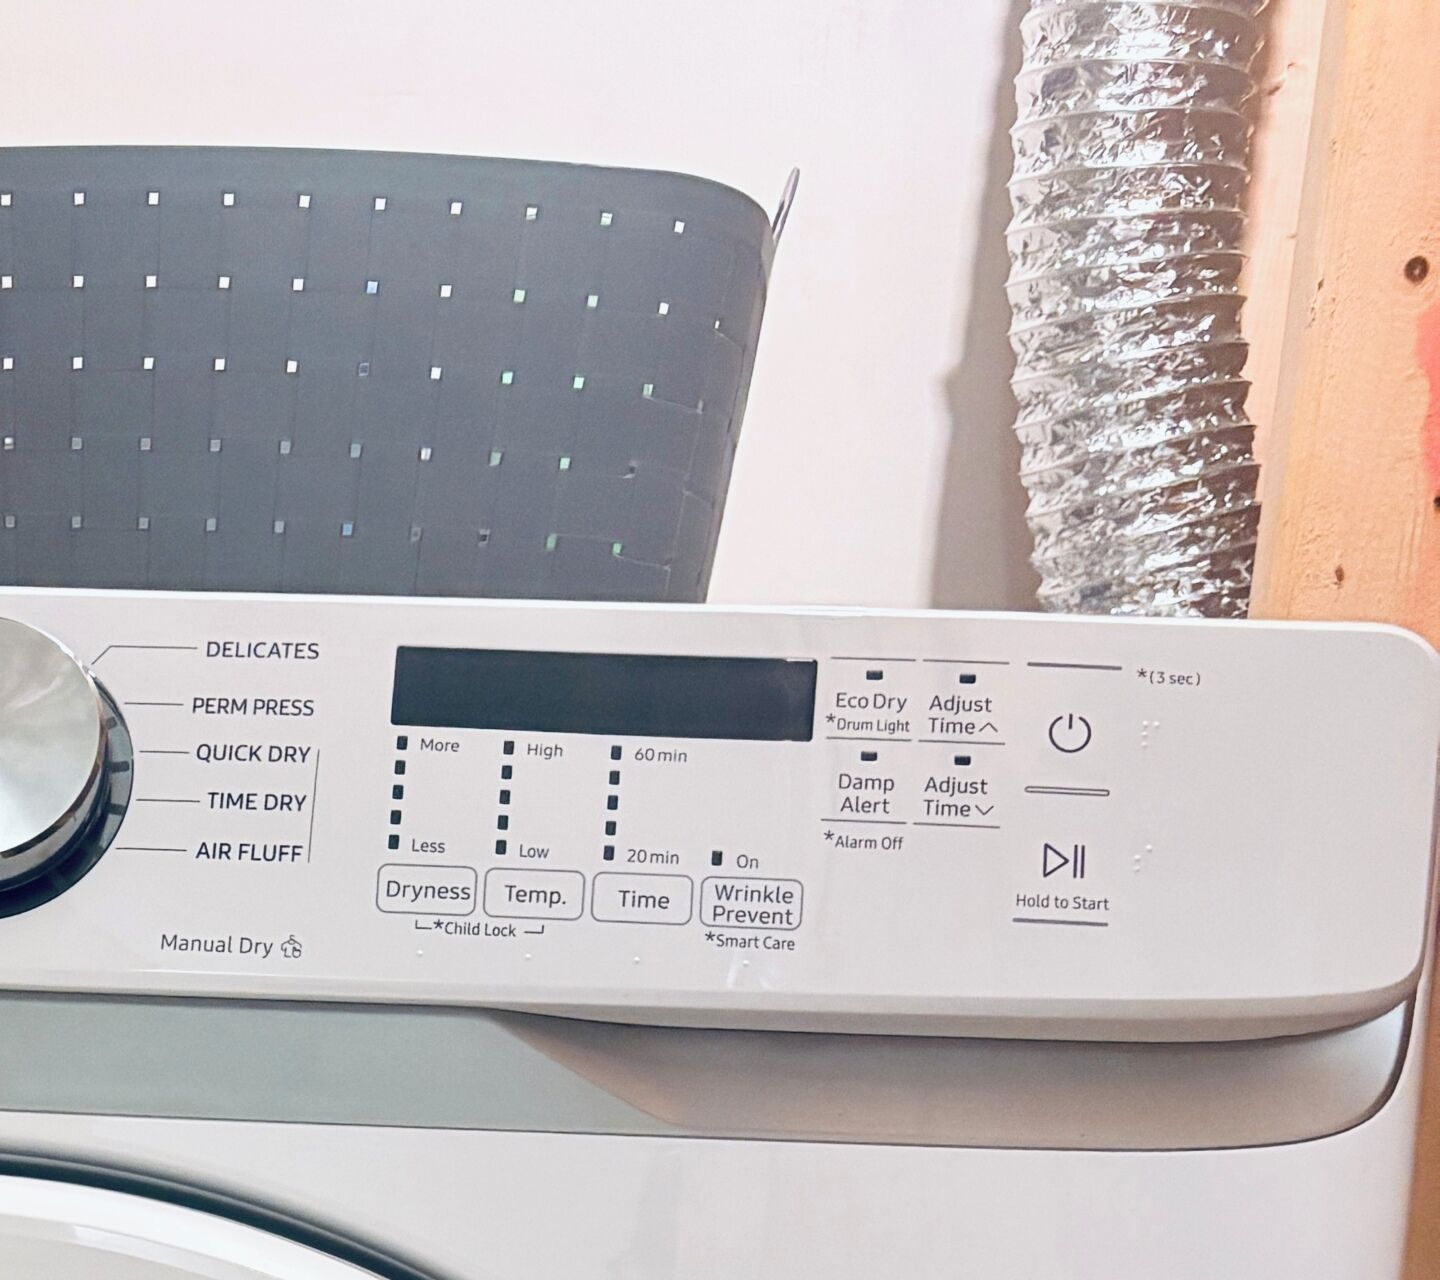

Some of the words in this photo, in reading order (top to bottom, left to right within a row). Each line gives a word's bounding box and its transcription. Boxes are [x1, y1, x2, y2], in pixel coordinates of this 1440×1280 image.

[206, 640, 320, 660] DELICATES
[1169, 672, 1201, 687] sec)
[192, 696, 248, 716] PERM
[252, 698, 315, 717] PRESS
[835, 692, 869, 710] Eco
[873, 692, 908, 714] Dry
[928, 694, 993, 716] Adjust
[876, 719, 910, 735] Light
[928, 716, 976, 735] Time
[196, 743, 263, 764] QUICK
[267, 745, 312, 764] DRY
[420, 737, 460, 753] More
[527, 743, 564, 761] High
[634, 747, 655, 762] 60
[657, 749, 688, 763] min
[838, 773, 895, 795] Damp
[924, 776, 989, 798] Adjust
[207, 791, 258, 811] TIME
[263, 793, 307, 812] DRY
[839, 795, 890, 815] Alert
[923, 799, 971, 818] Time
[195, 841, 232, 861] AIR
[237, 842, 304, 863] FLUFF
[411, 838, 446, 854] Less
[519, 843, 550, 859] Low
[881, 836, 904, 851] Off
[626, 848, 648, 864] 20
[649, 850, 680, 865] min
[736, 853, 759, 870] On
[386, 880, 471, 903] Dryness
[504, 884, 567, 909] Temp.
[617, 889, 670, 910] Time
[714, 883, 794, 905] Wrinkle
[1015, 893, 1050, 909] Hold
[1054, 895, 1069, 910] to
[1072, 895, 1110, 911] Start
[710, 904, 794, 927] Prevent
[484, 922, 517, 938] Lock
[160, 933, 233, 954] Manual
[239, 936, 274, 959] Dry
[762, 935, 796, 951] Care
